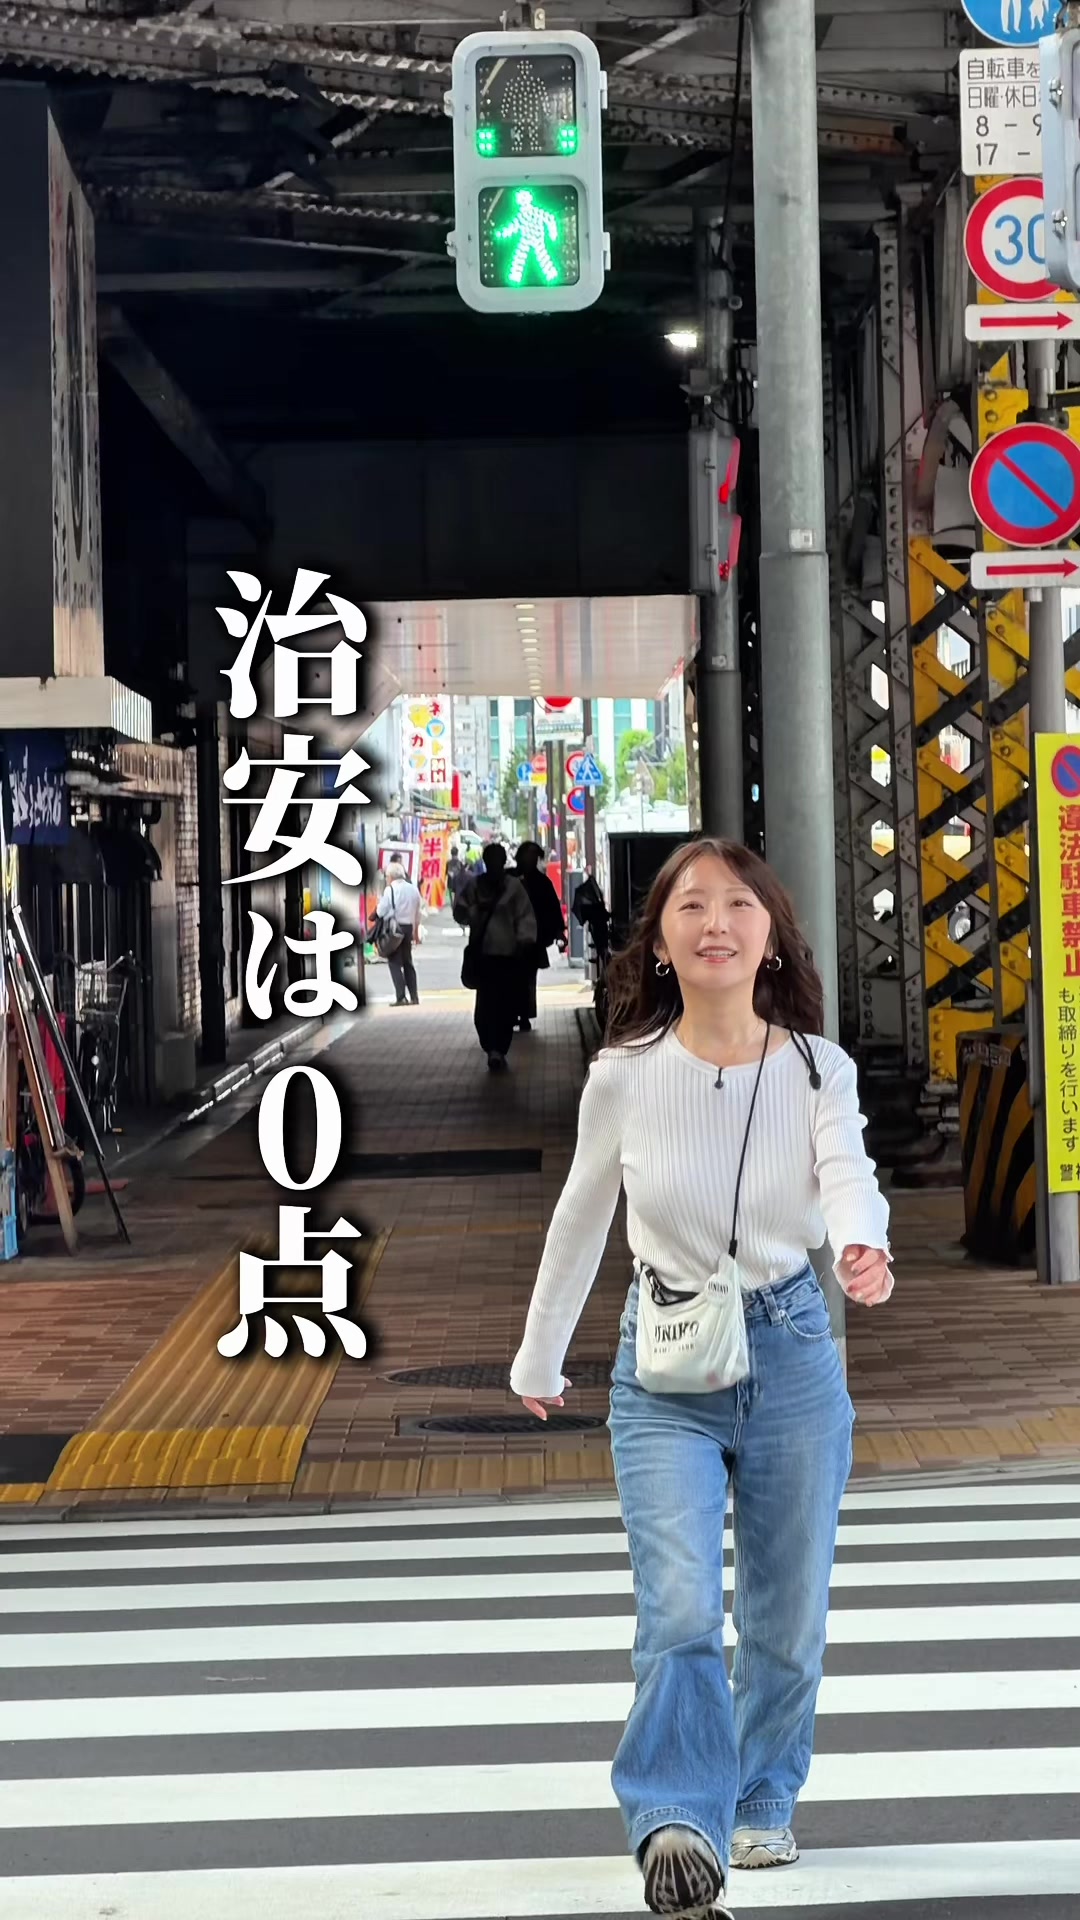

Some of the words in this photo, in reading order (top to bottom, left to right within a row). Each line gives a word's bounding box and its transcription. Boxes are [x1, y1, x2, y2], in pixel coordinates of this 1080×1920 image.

[967, 57, 1040, 80] 自転車を
[968, 85, 1041, 109] 日曜・休日
[976, 143, 998, 167] 17
[1058, 987, 1079, 1152] も取締りを行います
